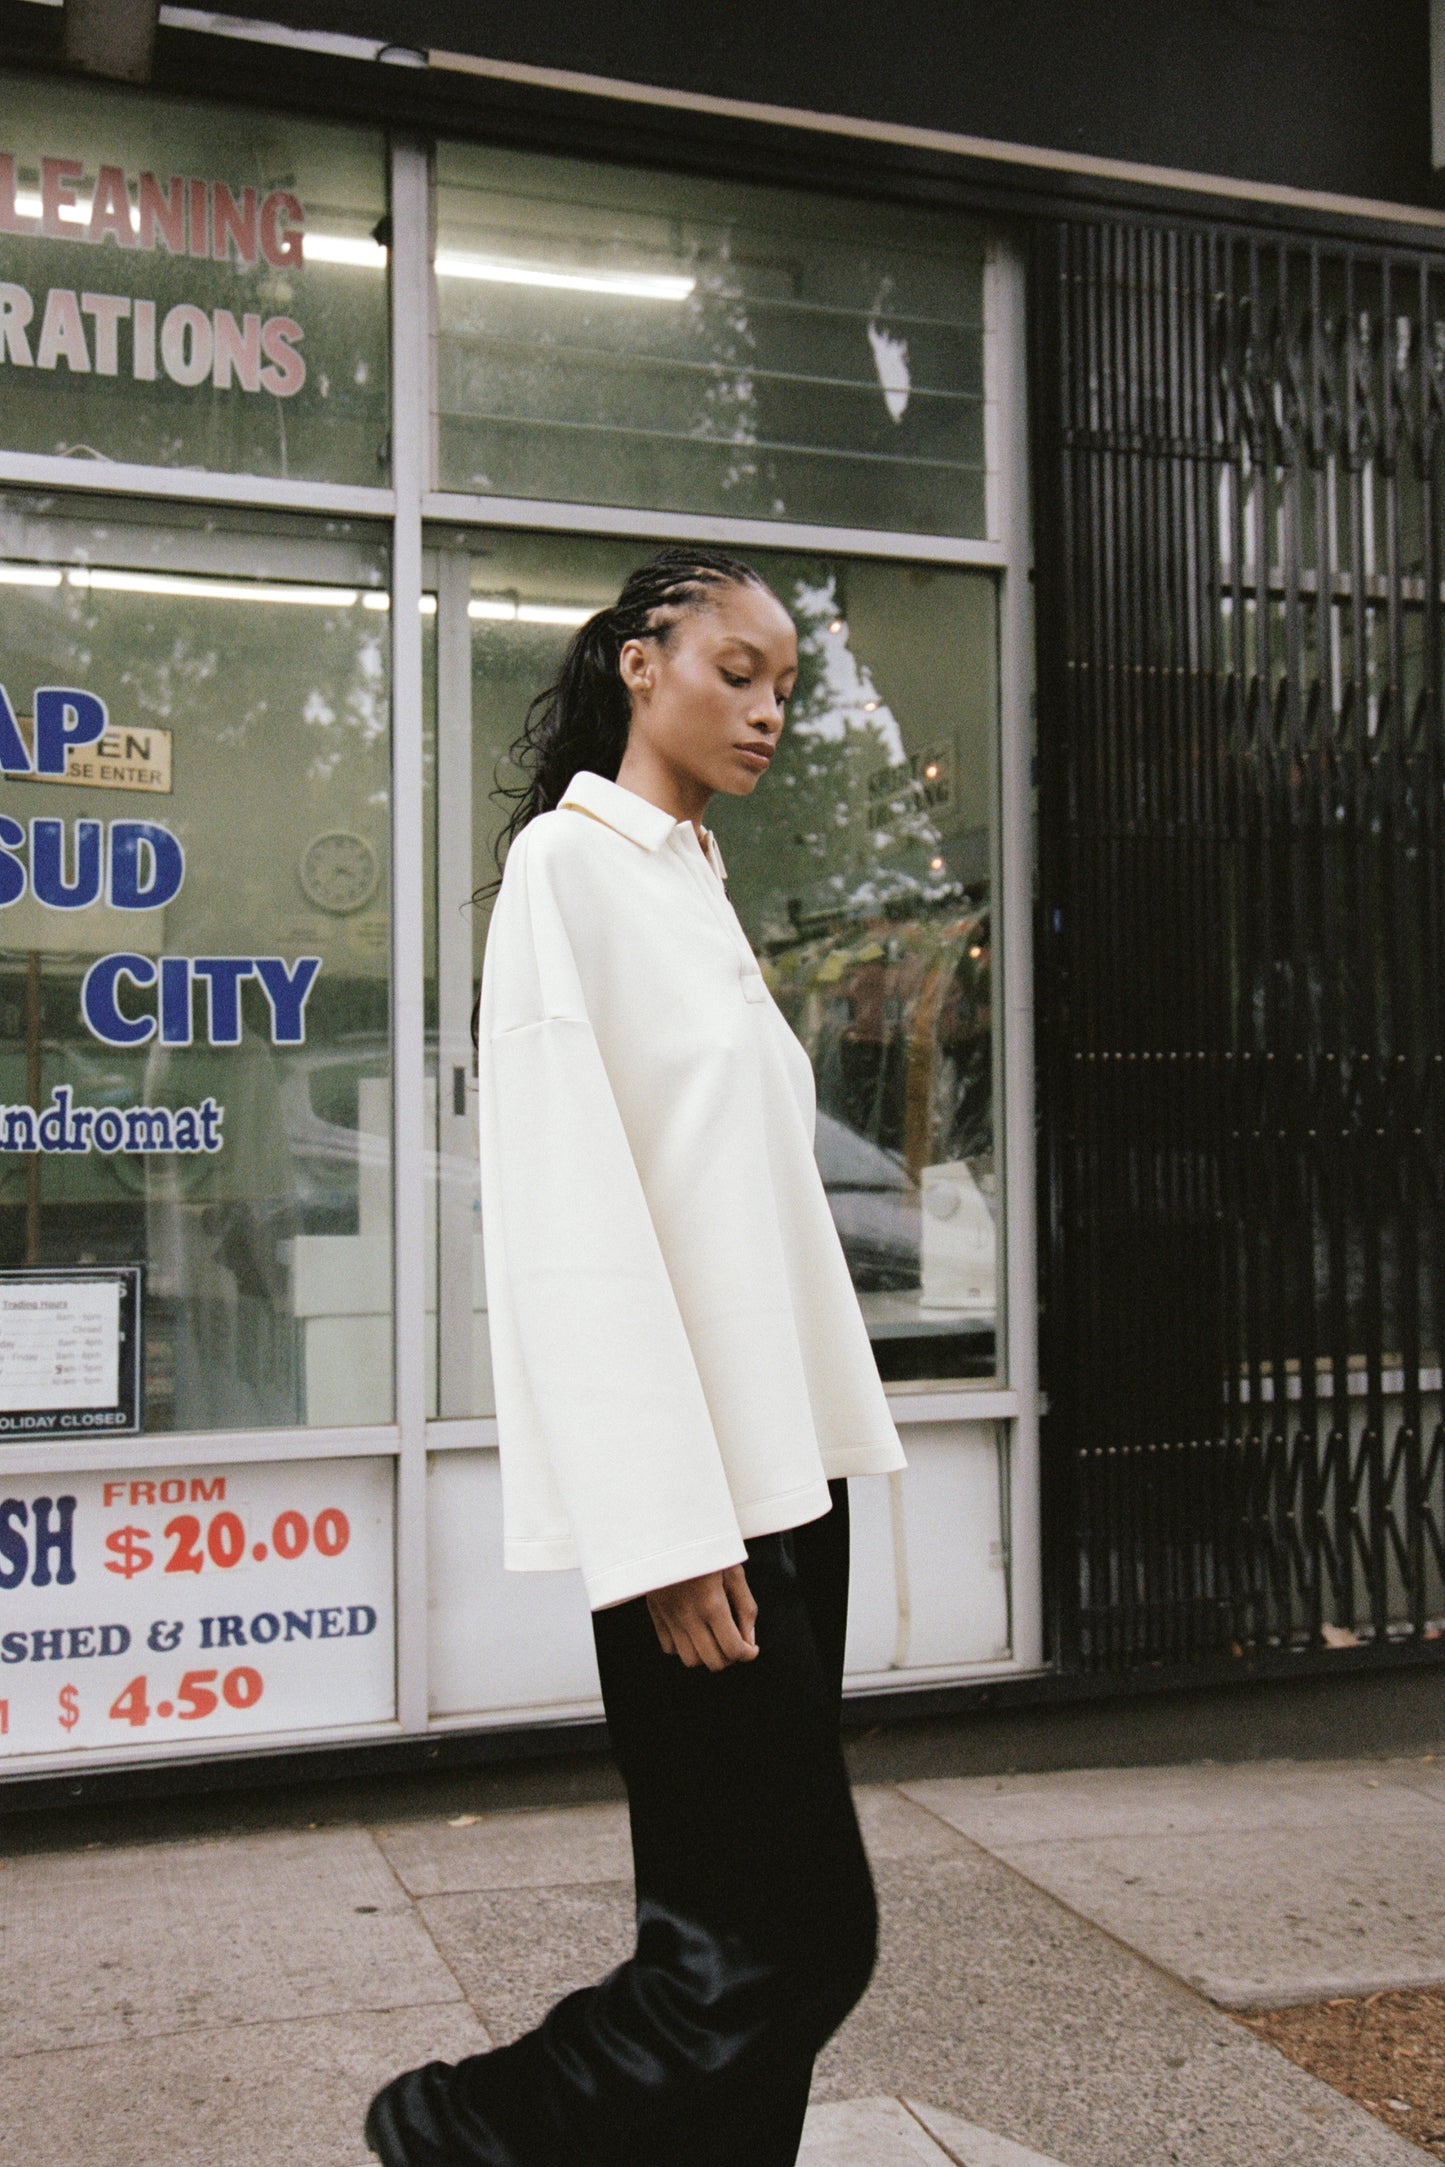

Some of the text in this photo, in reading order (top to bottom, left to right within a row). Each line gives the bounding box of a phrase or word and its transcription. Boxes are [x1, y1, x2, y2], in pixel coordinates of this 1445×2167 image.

[0, 153, 304, 270] LEANING
[0, 281, 306, 397] RATIONS
[101, 765, 162, 785] ENTER
[80, 952, 322, 1046] CITY
[0, 1084, 225, 1153] ndromat
[0, 1412, 127, 1430] OLIDAY CLOSED
[103, 1477, 226, 1507] FROM
[0, 1495, 350, 1590] SH $20.00
[0, 1605, 378, 1664] SHED & IRONED
